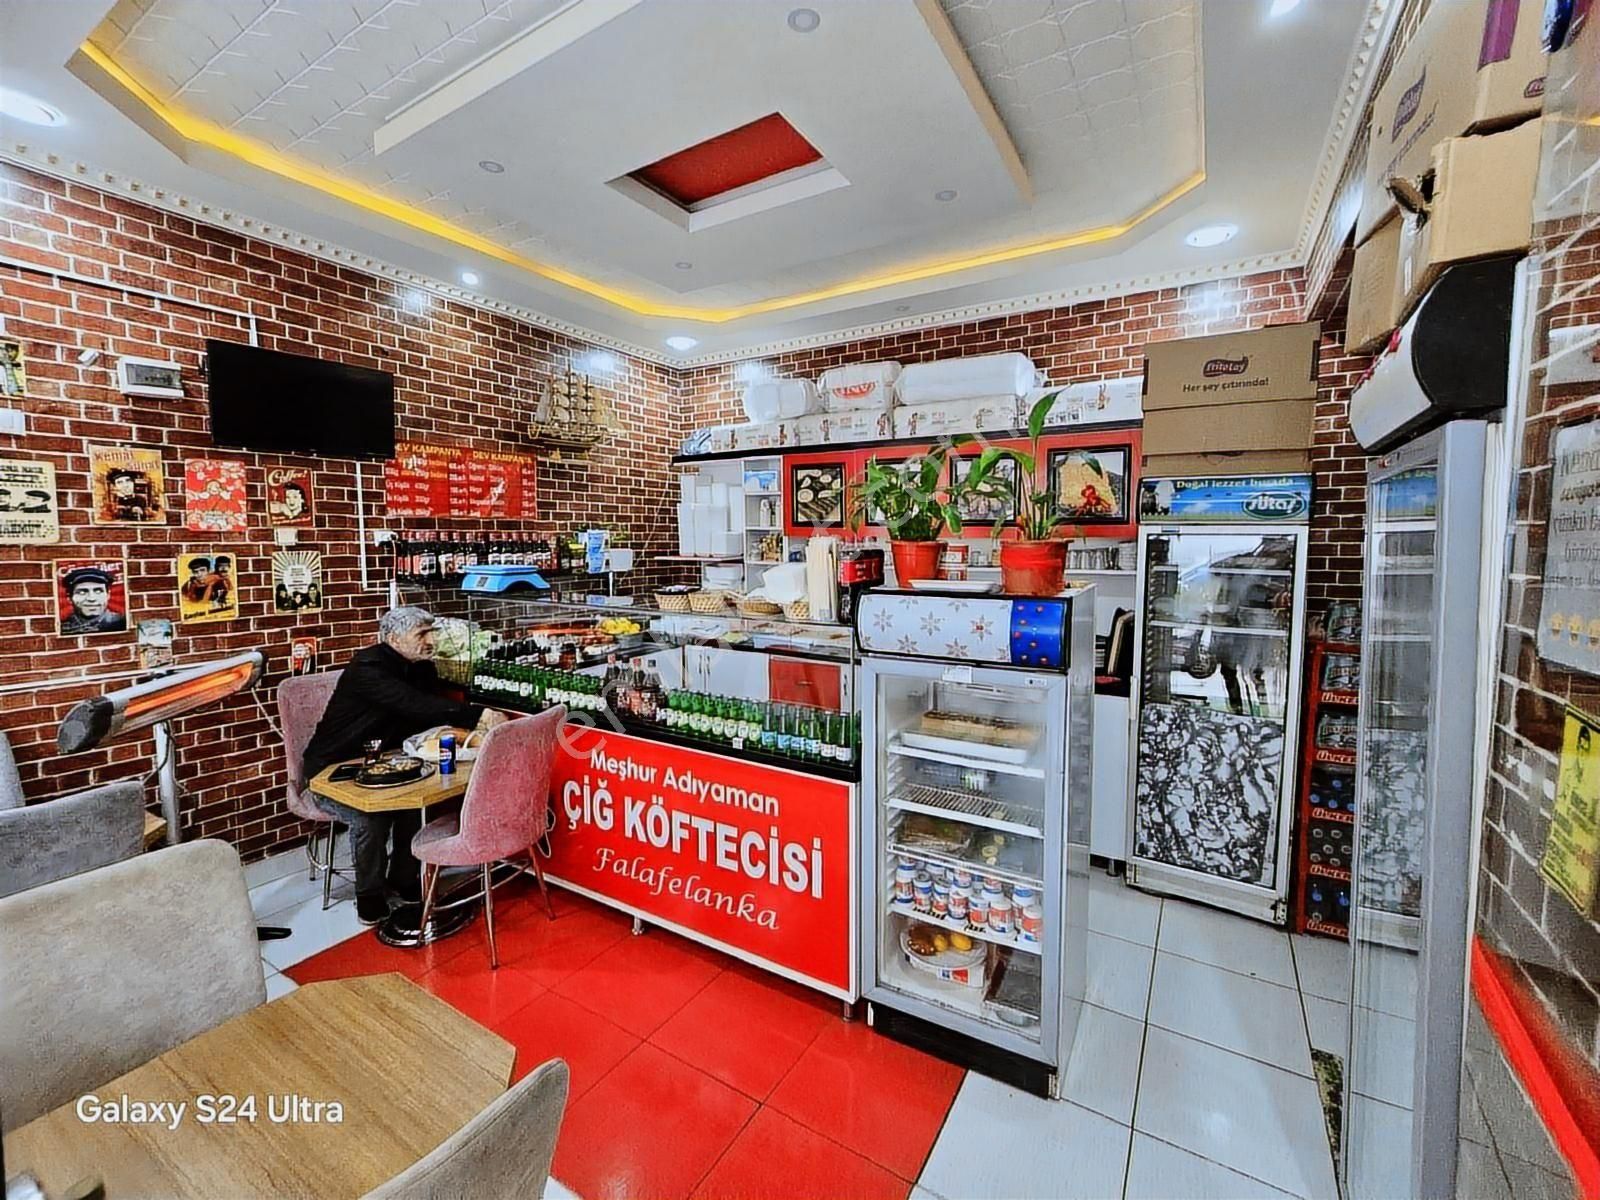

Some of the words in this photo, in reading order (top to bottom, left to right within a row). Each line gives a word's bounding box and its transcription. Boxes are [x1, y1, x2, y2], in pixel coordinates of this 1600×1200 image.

[1183, 383, 1200, 393] Her
[590, 748, 657, 783] Meşhur
[663, 767, 780, 817] Adıyaman
[563, 775, 614, 830] ÇİĞ
[624, 795, 823, 899] KÖFTECİSİ
[592, 848, 780, 930] Falafelanka
